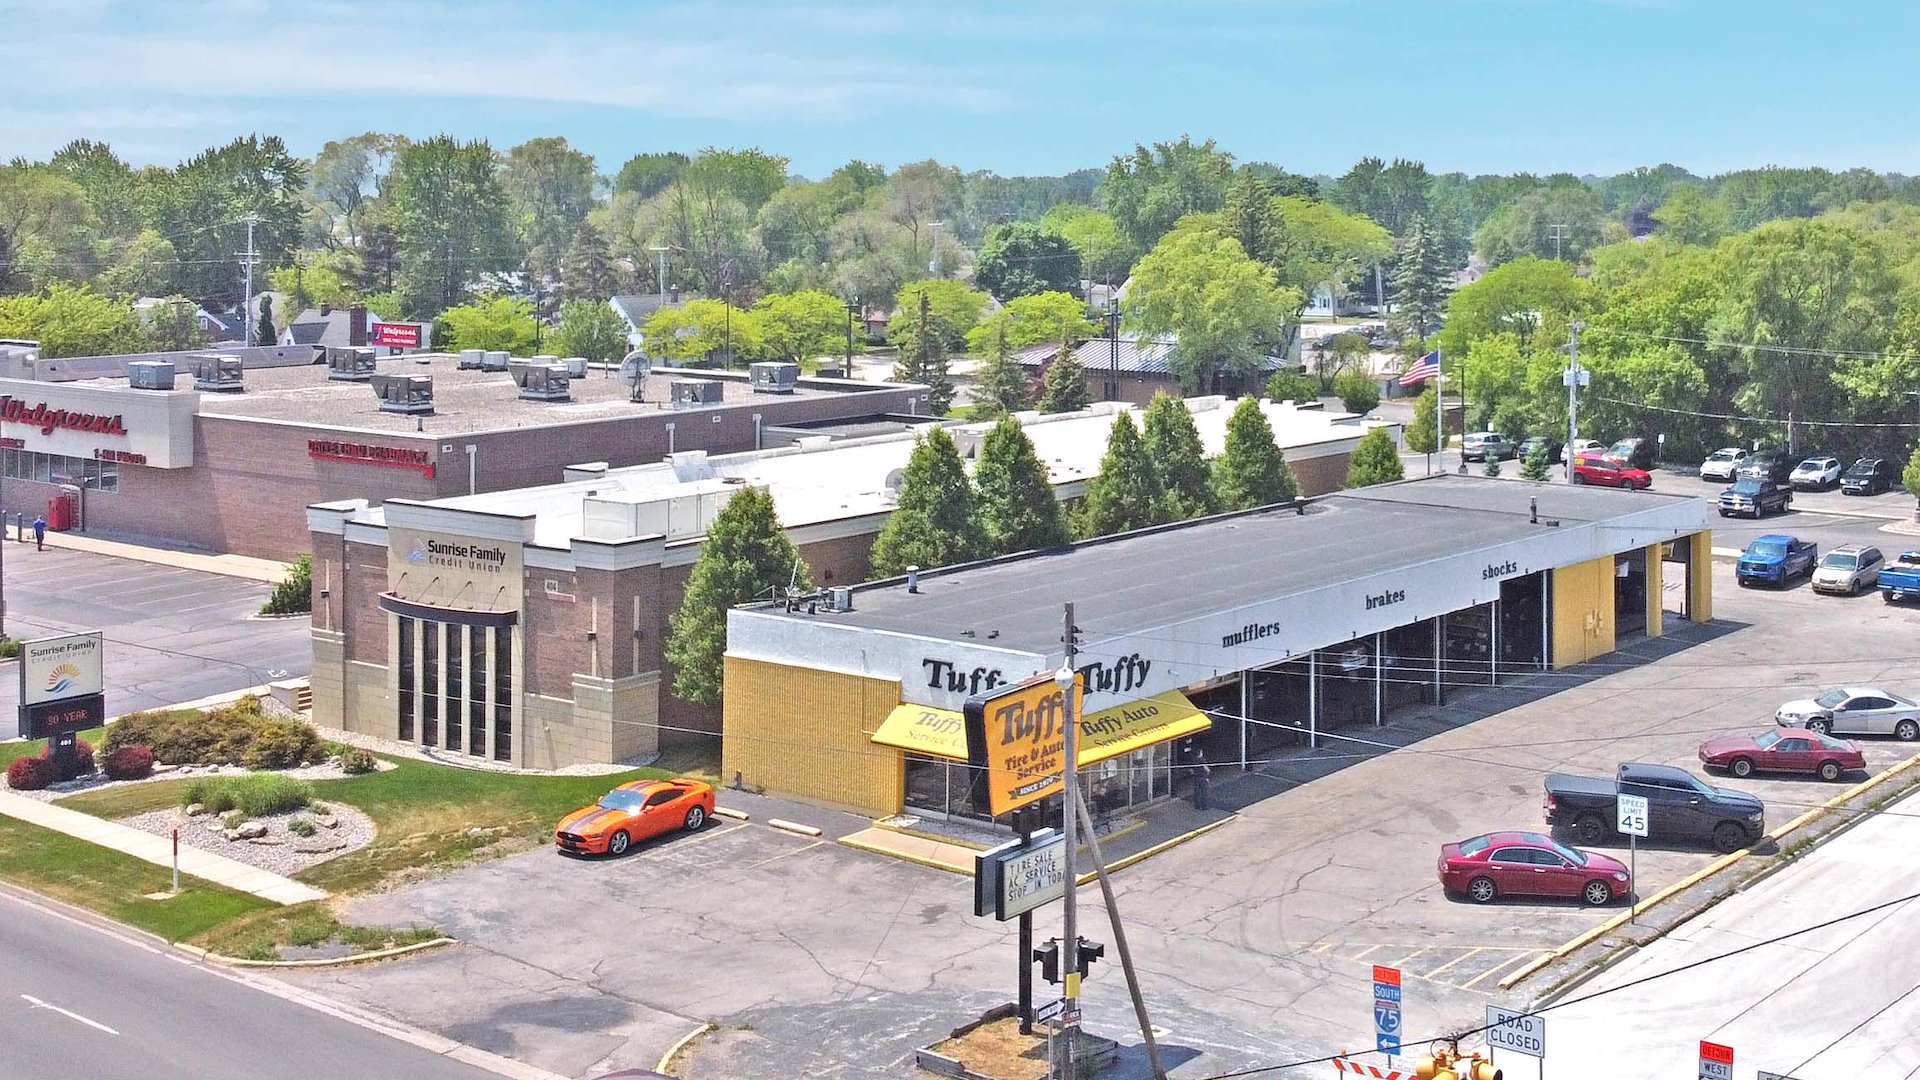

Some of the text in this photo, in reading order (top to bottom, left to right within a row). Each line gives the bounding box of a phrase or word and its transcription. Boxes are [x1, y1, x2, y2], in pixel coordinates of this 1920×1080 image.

[428, 540, 505, 565] Sunrise Family
[429, 556, 500, 573] Credit Union
[1483, 560, 1517, 580] shocks
[1365, 590, 1405, 609] brakes
[1222, 622, 1280, 648] mufflers
[30, 640, 97, 657] Sunrise Family
[923, 658, 1008, 696] Tuff
[1076, 653, 1150, 695] Tuffy
[64, 709, 88, 722] YEAR
[915, 711, 962, 734] Tuffy
[1125, 705, 1159, 724] Auto
[1093, 732, 1130, 748] Service
[1005, 754, 1028, 770] Tire
[1018, 758, 1056, 780] Service
[1621, 798, 1645, 808] SPEED
[1624, 806, 1642, 815] LIMIT
[1621, 815, 1645, 830] 45
[1010, 851, 1053, 875] TIRE SALE
[1009, 861, 1056, 888] AC SERVICE
[1008, 886, 1027, 902] STOP
[1048, 870, 1065, 885] TOD
[1375, 985, 1400, 1000] SOUTH
[1375, 1008, 1399, 1028] 75
[1498, 1013, 1533, 1032] ROAD
[1491, 1028, 1540, 1051] CLOSED
[1702, 1047, 1731, 1061] DETOUR
[1704, 1063, 1728, 1076] WEST
